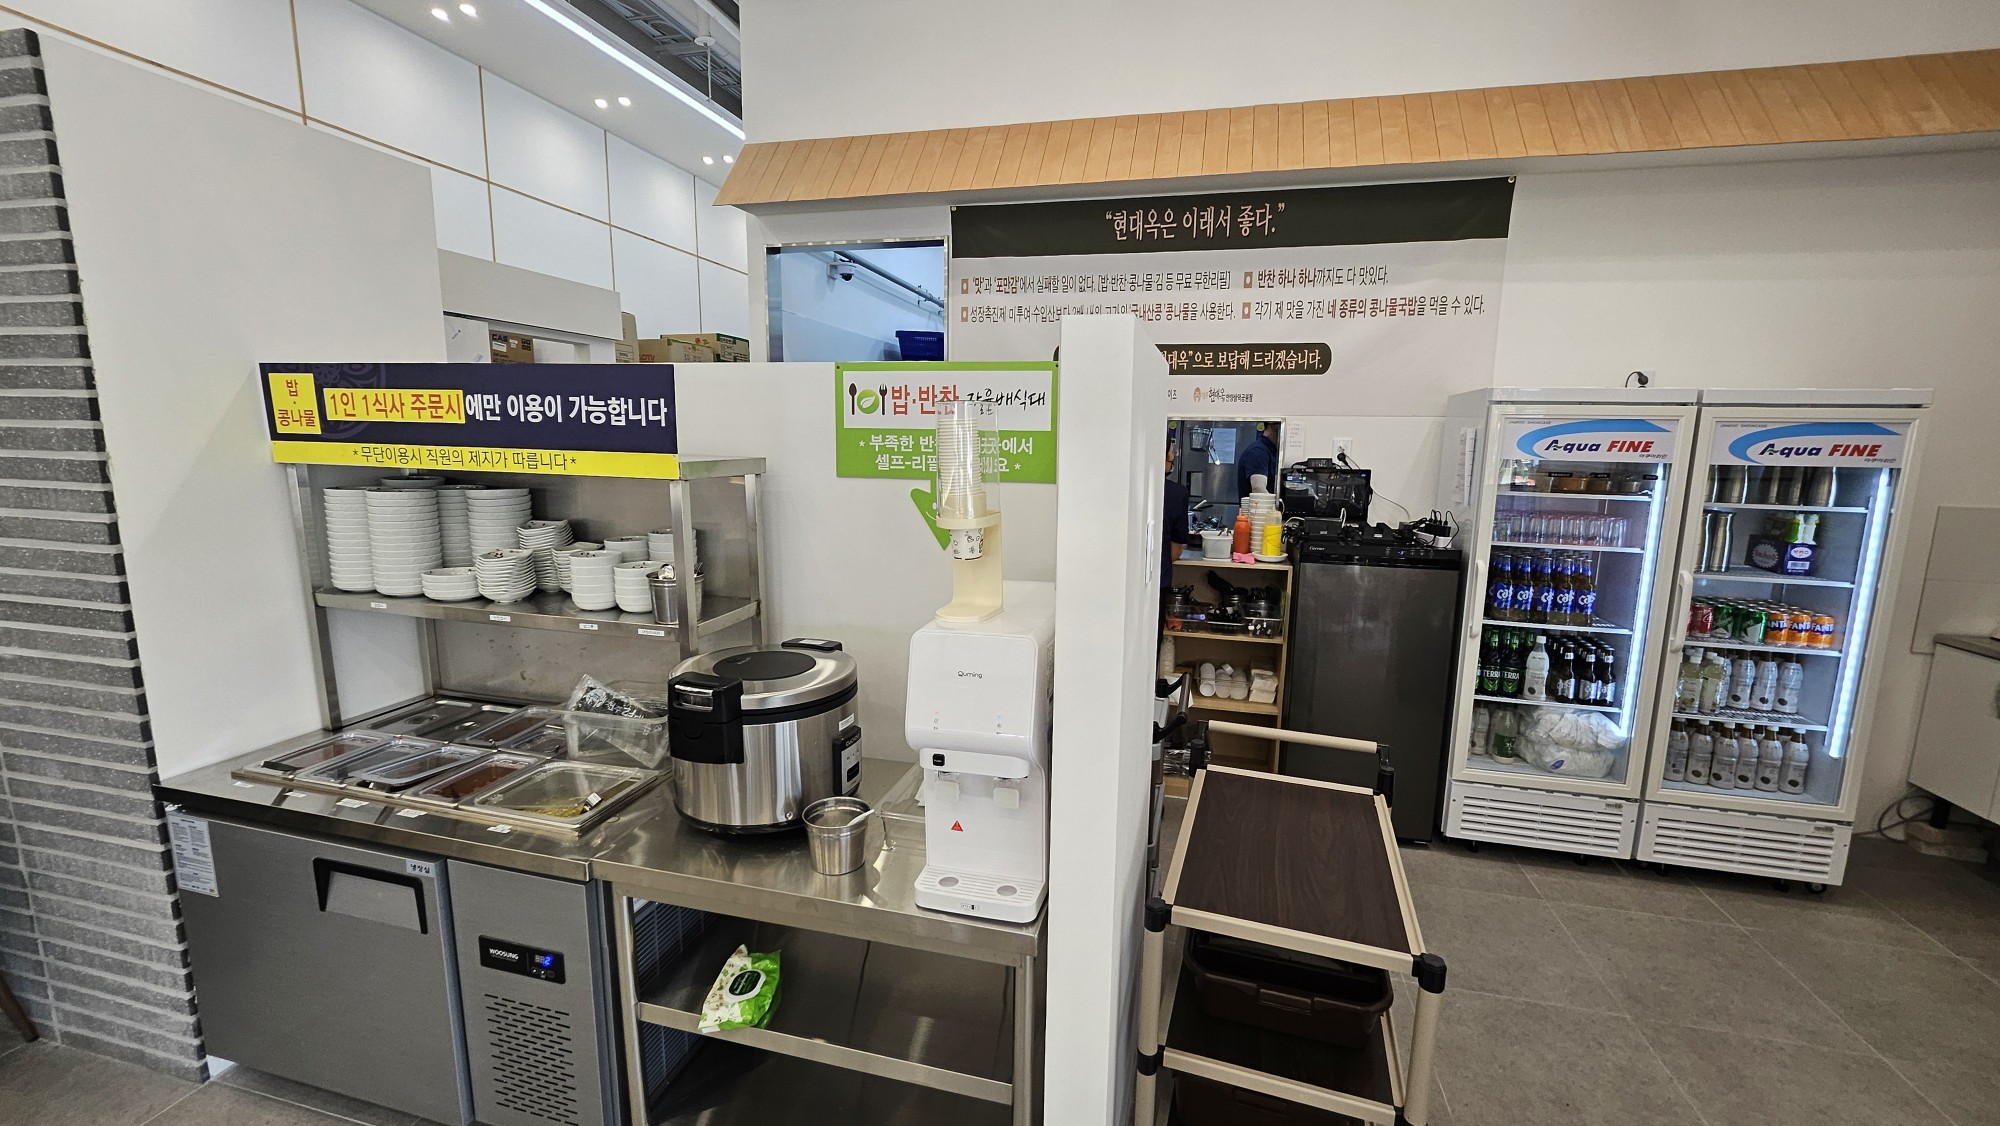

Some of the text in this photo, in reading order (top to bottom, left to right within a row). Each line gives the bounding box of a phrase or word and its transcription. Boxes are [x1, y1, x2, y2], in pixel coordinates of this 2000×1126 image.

[1105, 202, 1285, 241] “현대옥은 이래서 좋다.”
[1036, 275, 1059, 294] 실패할
[1061, 275, 1076, 293] 일이
[1176, 272, 1192, 291] 무료
[1257, 269, 1276, 289] 반찬
[1278, 269, 1296, 288] 하나
[1346, 267, 1356, 286] 다
[1286, 300, 1304, 320] 맛을
[1306, 299, 1325, 319] 가진
[1327, 298, 1336, 319] 네
[1339, 298, 1367, 318] 종류의
[1429, 295, 1448, 316] 먹을
[1450, 295, 1461, 315] 수
[1217, 349, 1250, 371] 보답해
[286, 379, 299, 397] 밥
[276, 409, 317, 429] 콩나물
[329, 391, 357, 419] 1인
[361, 391, 406, 420] 1식사
[506, 393, 563, 424] 이용이
[568, 395, 669, 428] 가능합니다
[868, 434, 914, 453] 부족한
[1606, 440, 1655, 453] FINE
[1828, 444, 1883, 457] FINE
[426, 448, 463, 468] 직원의
[468, 449, 508, 469] 제지가
[410, 863, 431, 875] 냉장실
[489, 947, 520, 961] WOOSUNG
